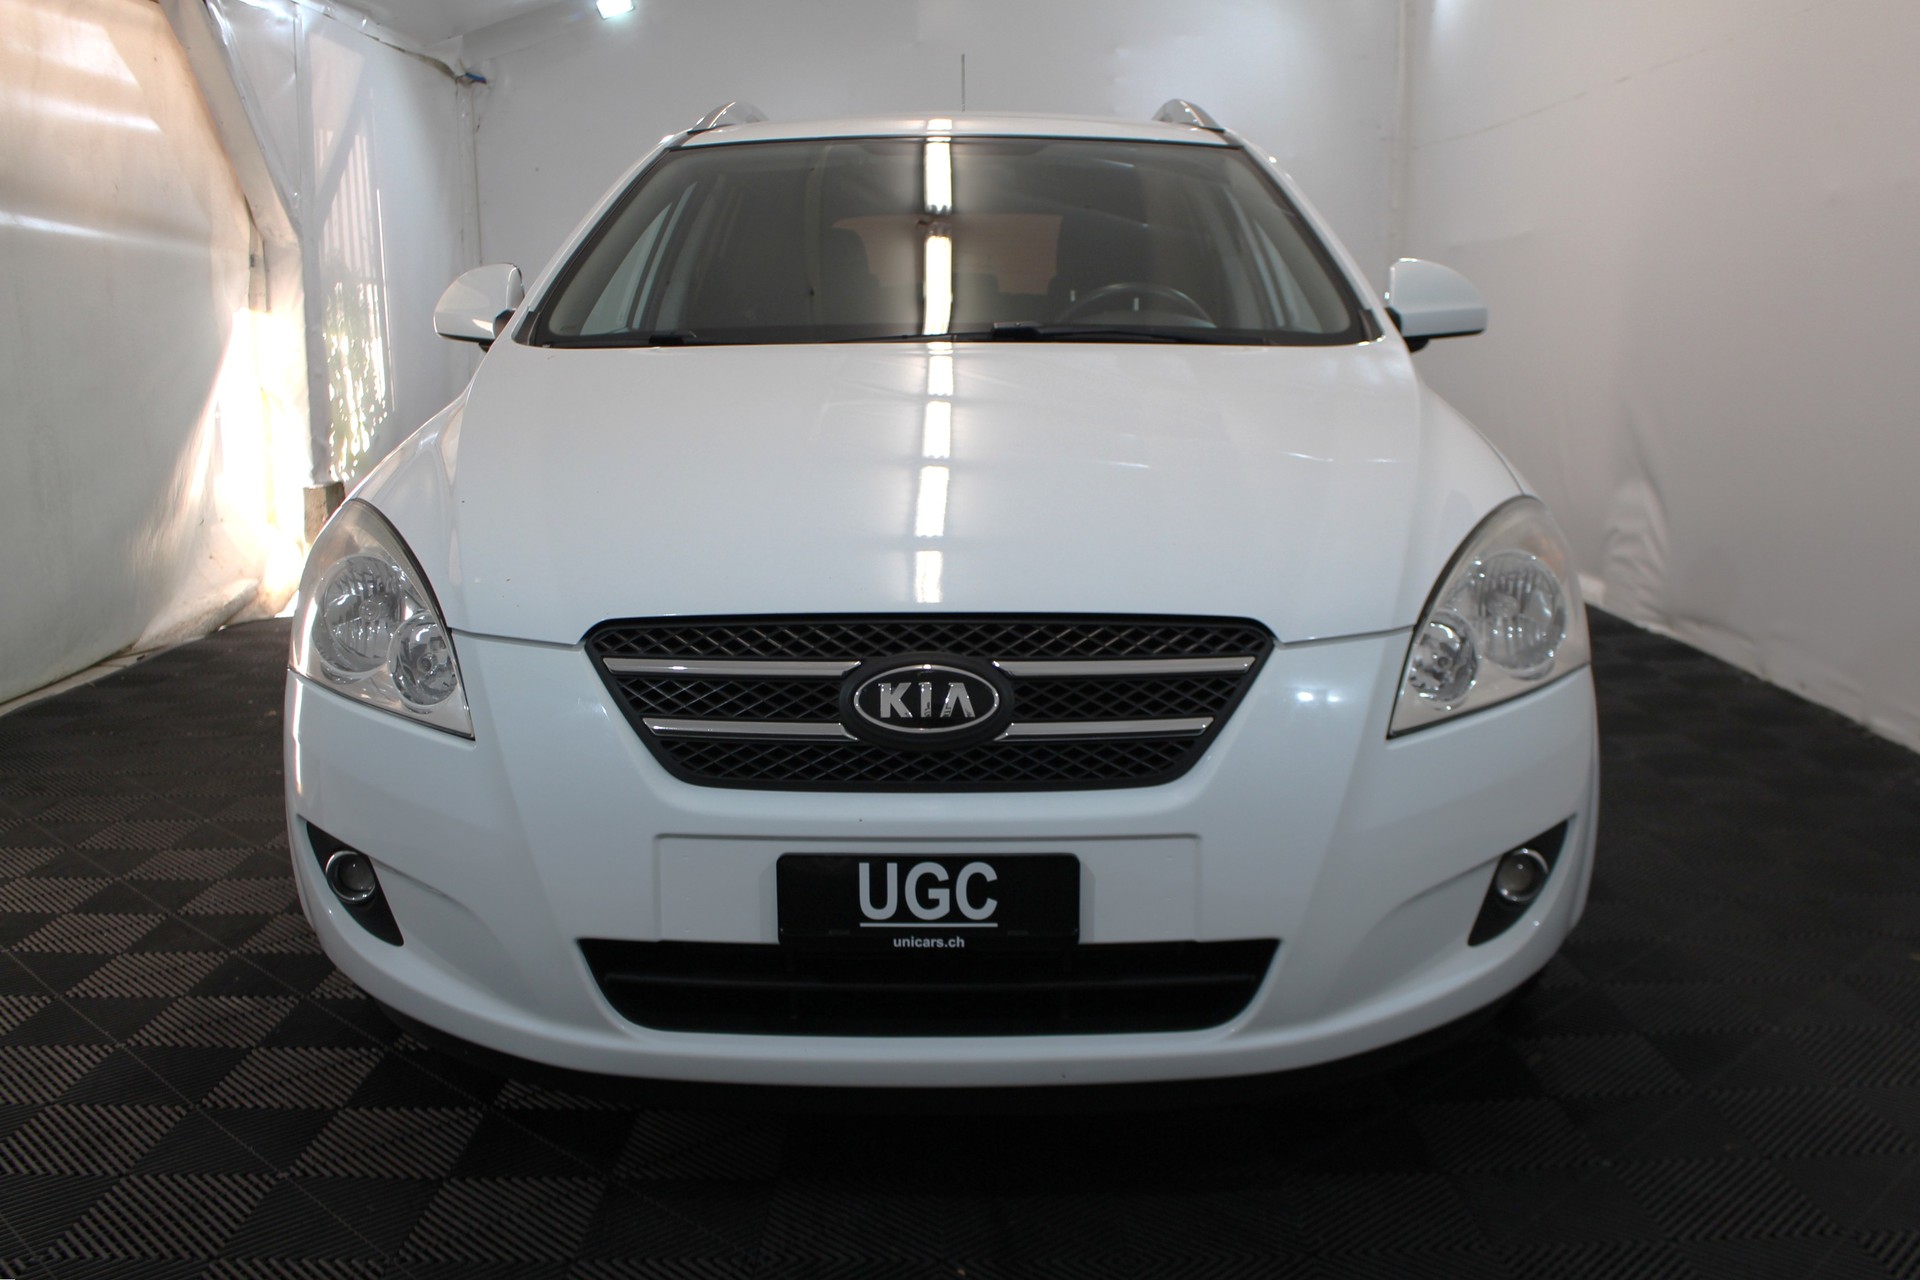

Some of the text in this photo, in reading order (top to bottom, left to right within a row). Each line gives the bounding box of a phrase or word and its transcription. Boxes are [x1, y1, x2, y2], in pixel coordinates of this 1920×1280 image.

[878, 682, 976, 718] KIA
[858, 862, 998, 920] UGC
[893, 936, 965, 948] unicars.ch
